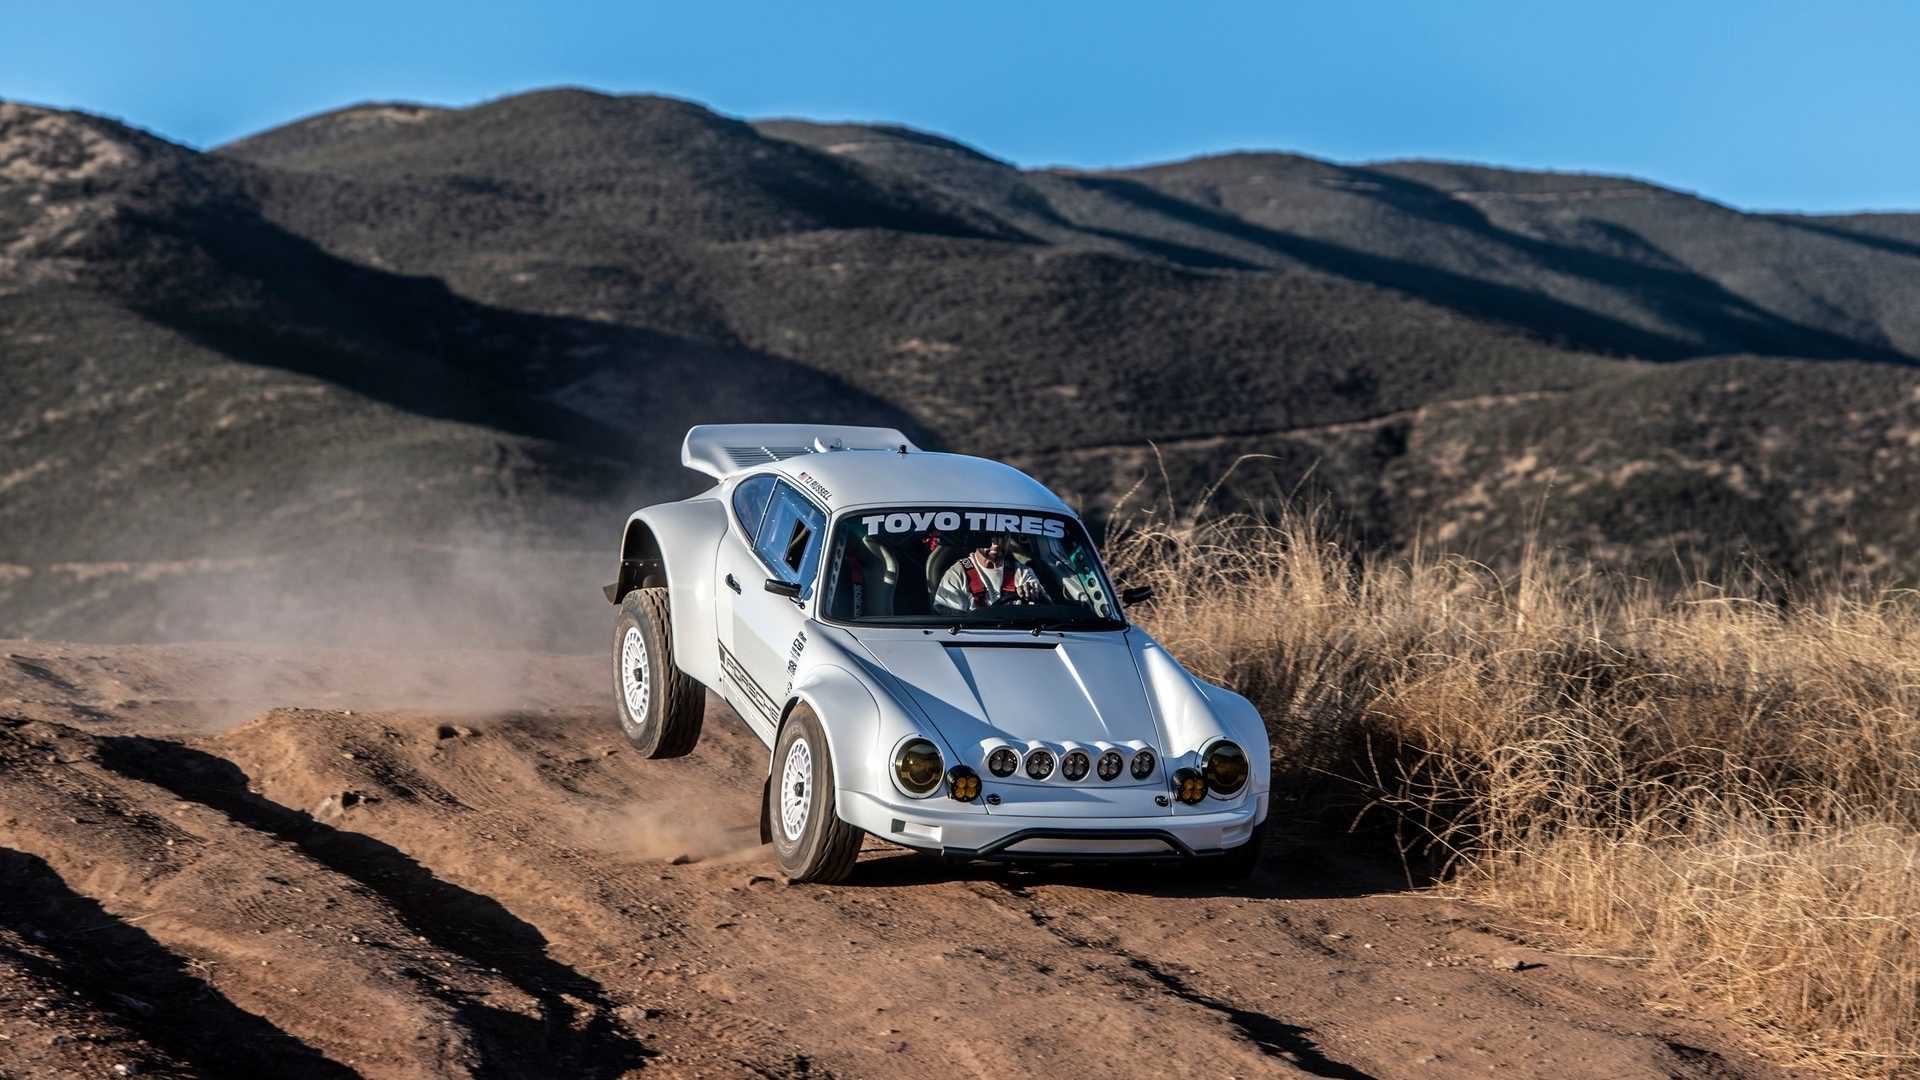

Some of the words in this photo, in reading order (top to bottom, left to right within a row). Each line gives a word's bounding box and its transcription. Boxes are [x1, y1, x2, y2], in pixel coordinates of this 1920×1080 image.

[810, 480, 832, 500] RUSSELL
[862, 512, 961, 536] TOYO
[965, 512, 1065, 539] TIRES
[726, 657, 779, 721] PORSCHE
